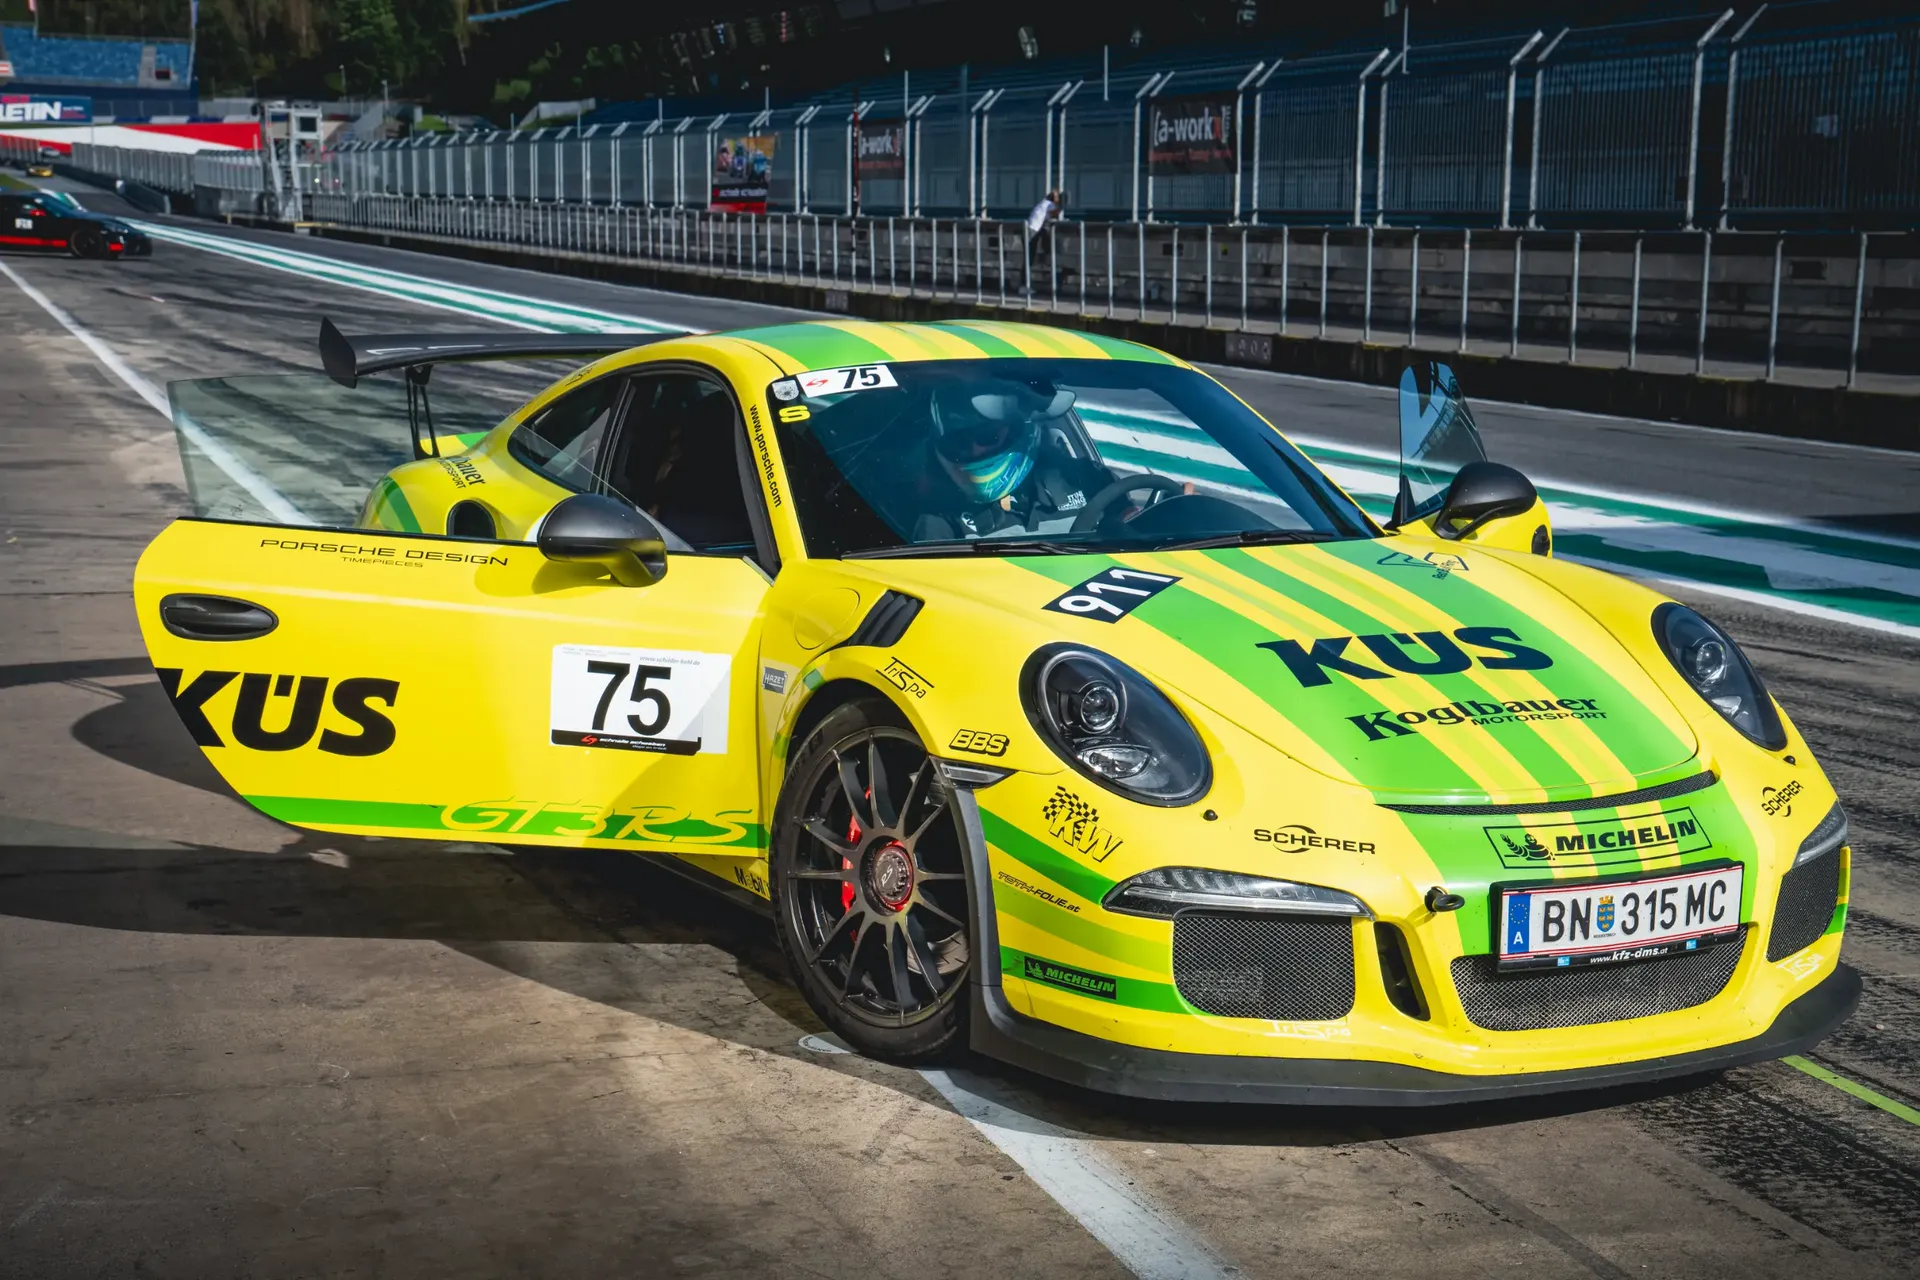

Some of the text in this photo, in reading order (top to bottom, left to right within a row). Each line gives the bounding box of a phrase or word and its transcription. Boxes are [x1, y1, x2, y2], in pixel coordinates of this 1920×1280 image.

[837, 366, 882, 390] 75
[778, 404, 811, 424] S
[749, 404, 783, 508] www.porsche.com
[260, 539, 509, 567] PORSCHE DESIGN
[341, 556, 424, 568] TIMEPIECES
[1058, 568, 1174, 617] 911
[1254, 626, 1554, 689] KÜS
[763, 672, 785, 686] HAZET
[875, 656, 935, 699] TriSpa
[154, 667, 401, 758] KÜS
[587, 659, 672, 736] 75
[1344, 698, 1602, 742] Koglbauer
[1470, 711, 1608, 727] MOTORSPORT
[948, 728, 1011, 757] BBS
[1761, 780, 1804, 816] SCHERER
[1048, 805, 1124, 863] KW
[1253, 827, 1376, 855] SCHERER
[1555, 818, 1697, 852] MICHELIN
[1543, 879, 1727, 943] BN 315 MC
[1513, 930, 1525, 945] A
[1590, 946, 1669, 964] www.kfz-dms.at
[1045, 967, 1115, 993] MICHELIN
